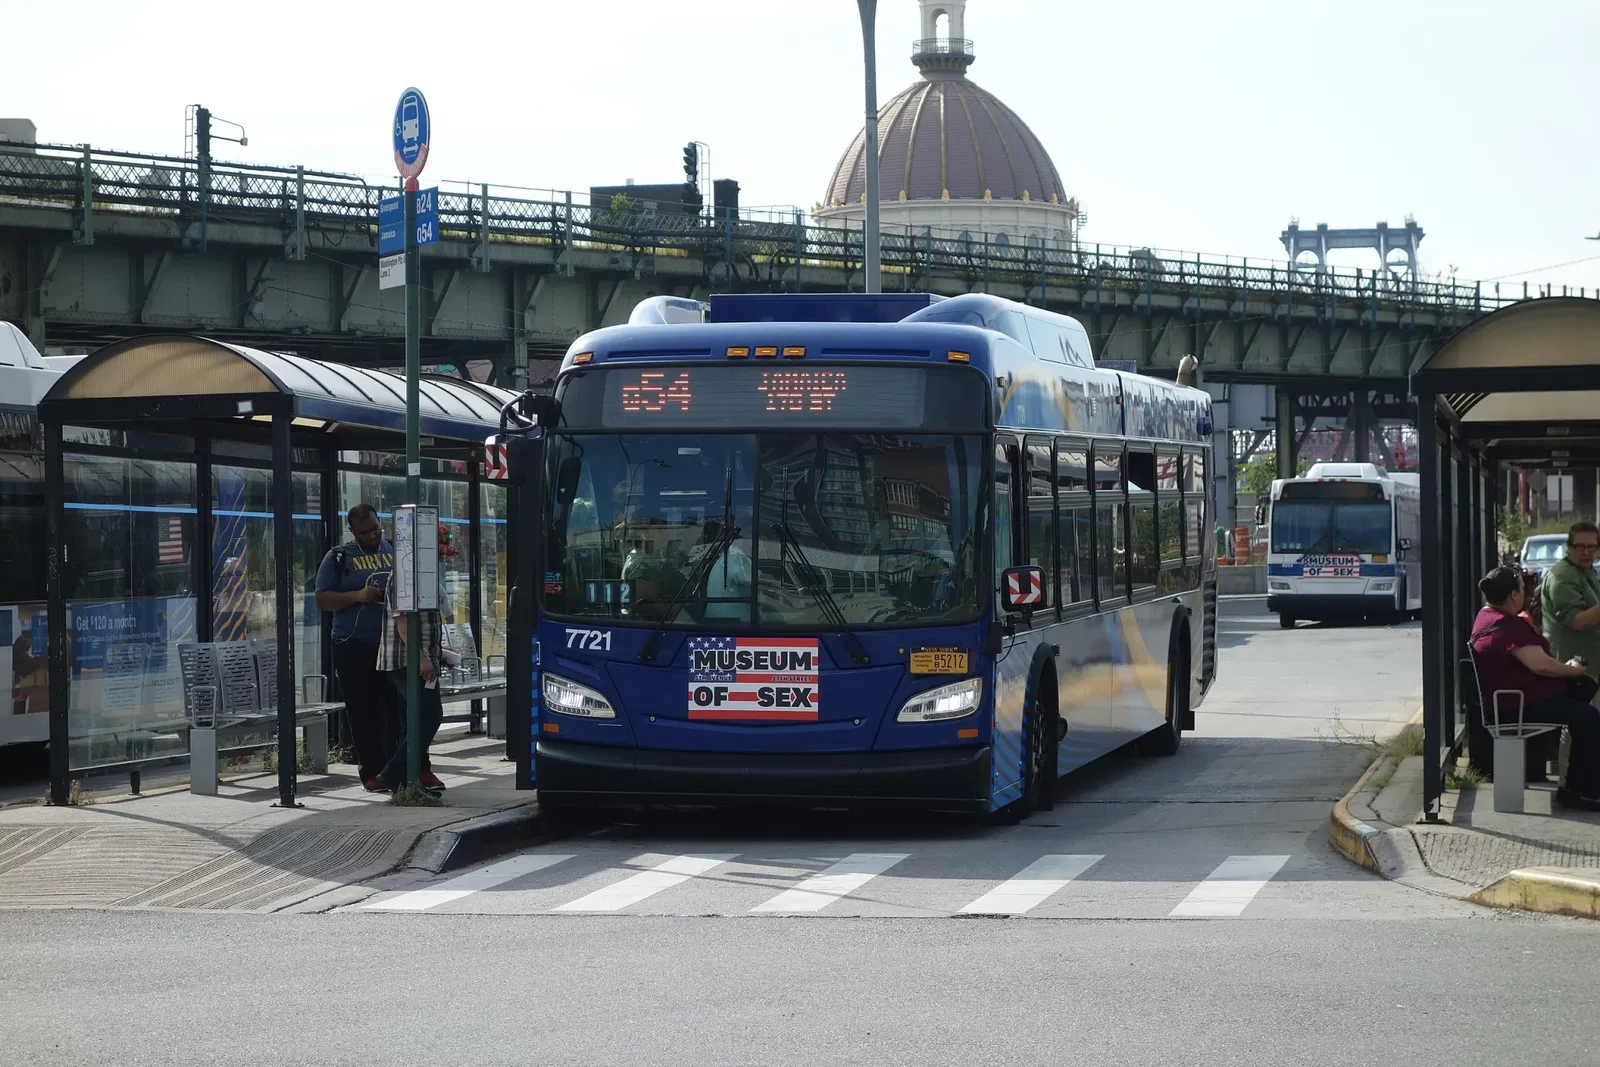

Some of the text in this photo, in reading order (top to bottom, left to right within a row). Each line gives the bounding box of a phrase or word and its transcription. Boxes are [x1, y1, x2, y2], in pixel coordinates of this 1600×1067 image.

[416, 192, 432, 214] B24
[416, 221, 433, 243] Q54
[1309, 556, 1354, 565] MUSEUM
[1309, 568, 1354, 576] OF SEX
[76, 615, 89, 631] Get
[91, 615, 107, 630] $120
[108, 619, 113, 629] a
[565, 628, 612, 651] 7721
[693, 650, 812, 671] MUSEUM
[940, 654, 964, 668] 5212
[693, 686, 812, 708] OF SEX
